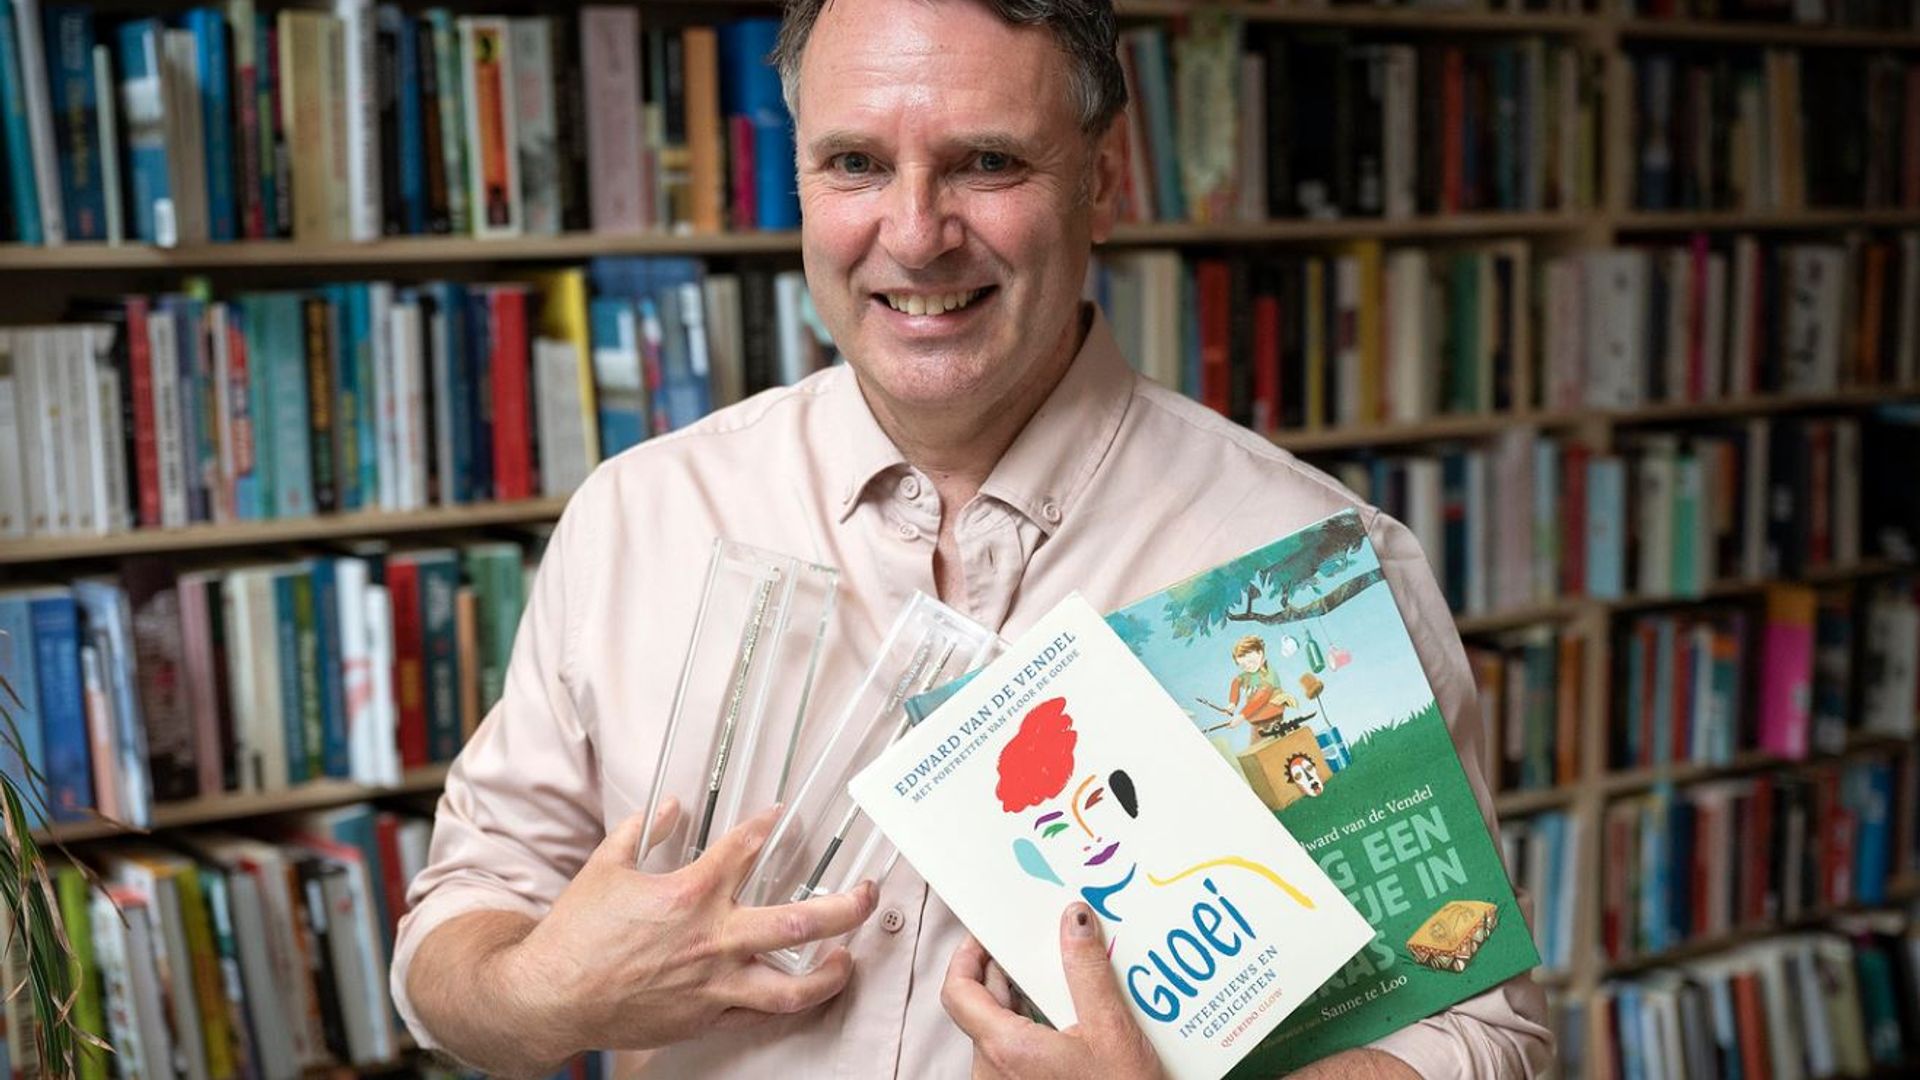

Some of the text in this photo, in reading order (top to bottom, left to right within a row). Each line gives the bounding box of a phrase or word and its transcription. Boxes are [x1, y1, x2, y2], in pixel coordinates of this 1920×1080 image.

[894, 632, 1076, 796] EDWARD VAN DE VENDEL
[912, 649, 1080, 802] MET PORTRETTEN VAN FLOOR DE GOEDE
[1300, 784, 1433, 851] ward van de Vendel
[1319, 805, 1450, 890] G EEN
[1414, 846, 1468, 900] IN
[1128, 878, 1257, 1022] Gloei
[1179, 963, 1258, 1038] INTERVIEWS
[1258, 945, 1278, 966] EN
[1202, 968, 1277, 1039] GEDICHTEN
[1221, 1011, 1259, 1048] QUERIDO
[1321, 974, 1407, 1021] Sanne te Loo
